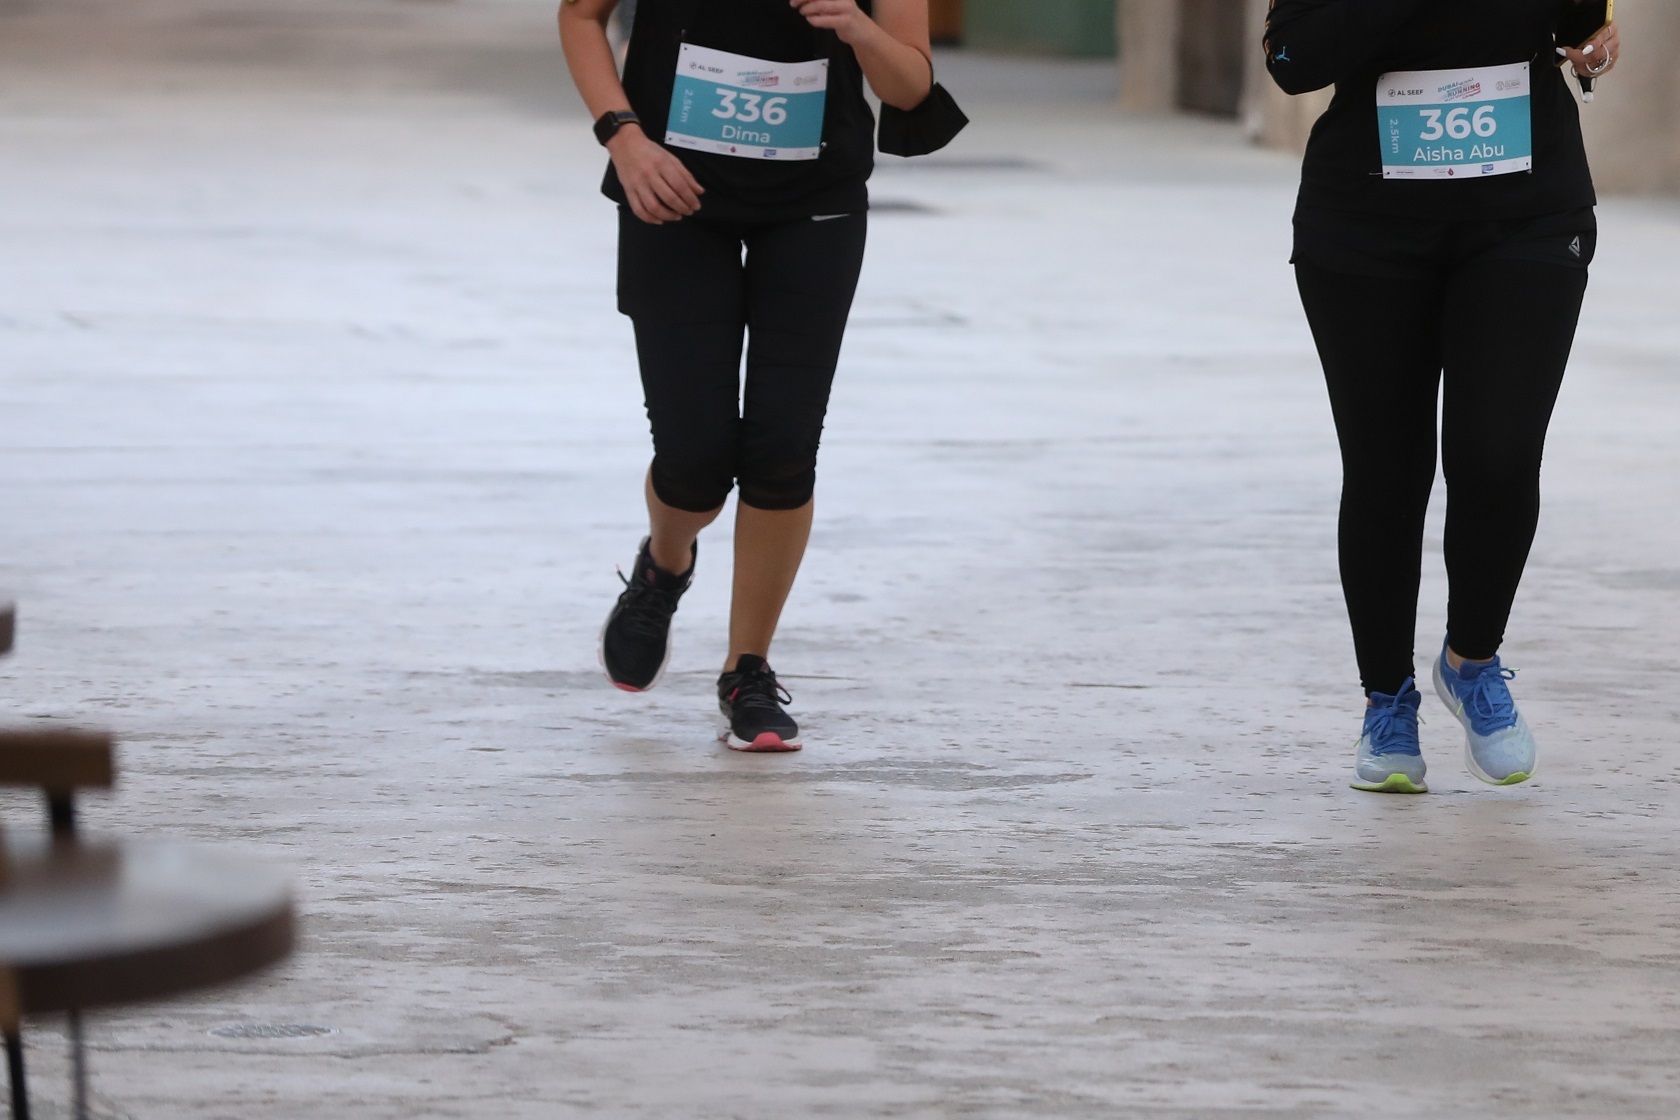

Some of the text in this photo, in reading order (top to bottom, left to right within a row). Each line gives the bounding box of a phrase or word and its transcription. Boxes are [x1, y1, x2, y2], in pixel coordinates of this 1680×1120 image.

[1447, 82, 1481, 98] RUNNING
[711, 88, 788, 125] 336
[1419, 105, 1497, 141] 366
[721, 125, 771, 144] Dima
[1413, 142, 1505, 162] Aisha Abu
